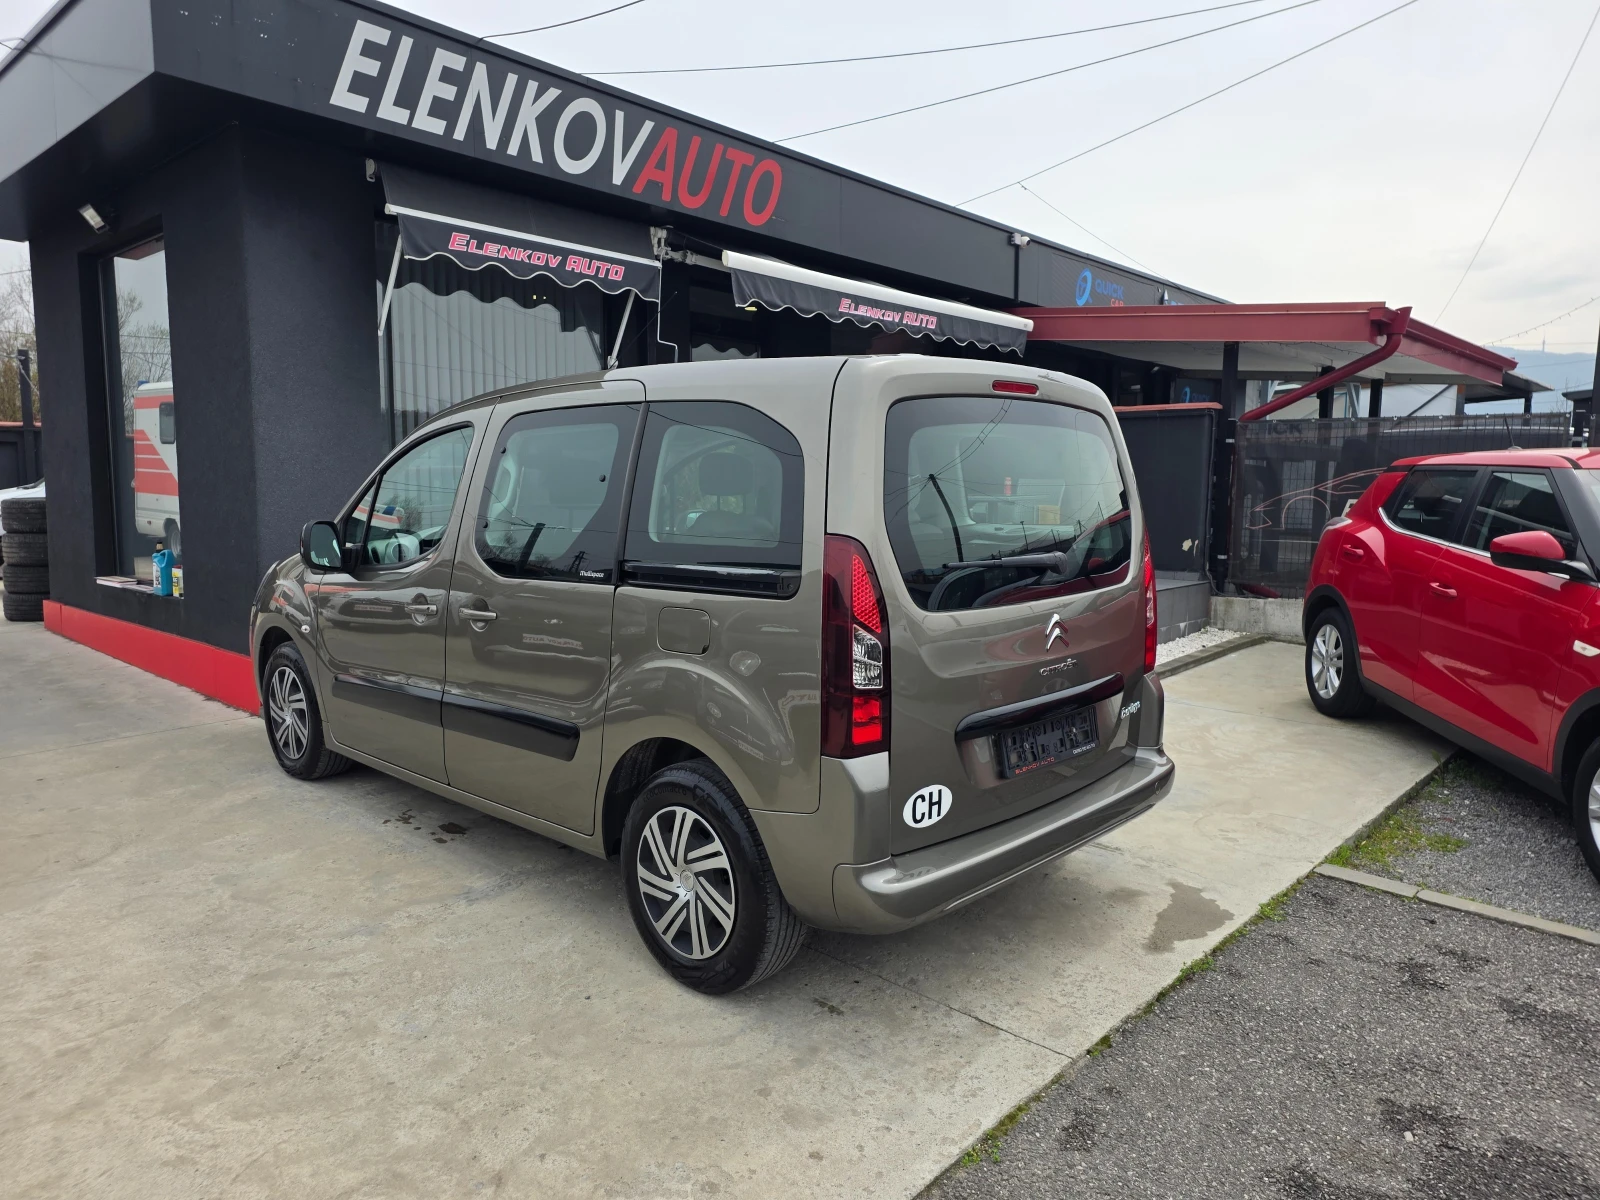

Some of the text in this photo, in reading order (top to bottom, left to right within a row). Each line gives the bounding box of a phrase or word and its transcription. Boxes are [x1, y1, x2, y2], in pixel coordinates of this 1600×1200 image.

[329, 19, 783, 227] ELENKOV AUTO
[565, 255, 625, 281] AUTO
[1095, 279, 1124, 300] QUICK
[902, 311, 938, 329] AUTO
[911, 788, 943, 825] CH
